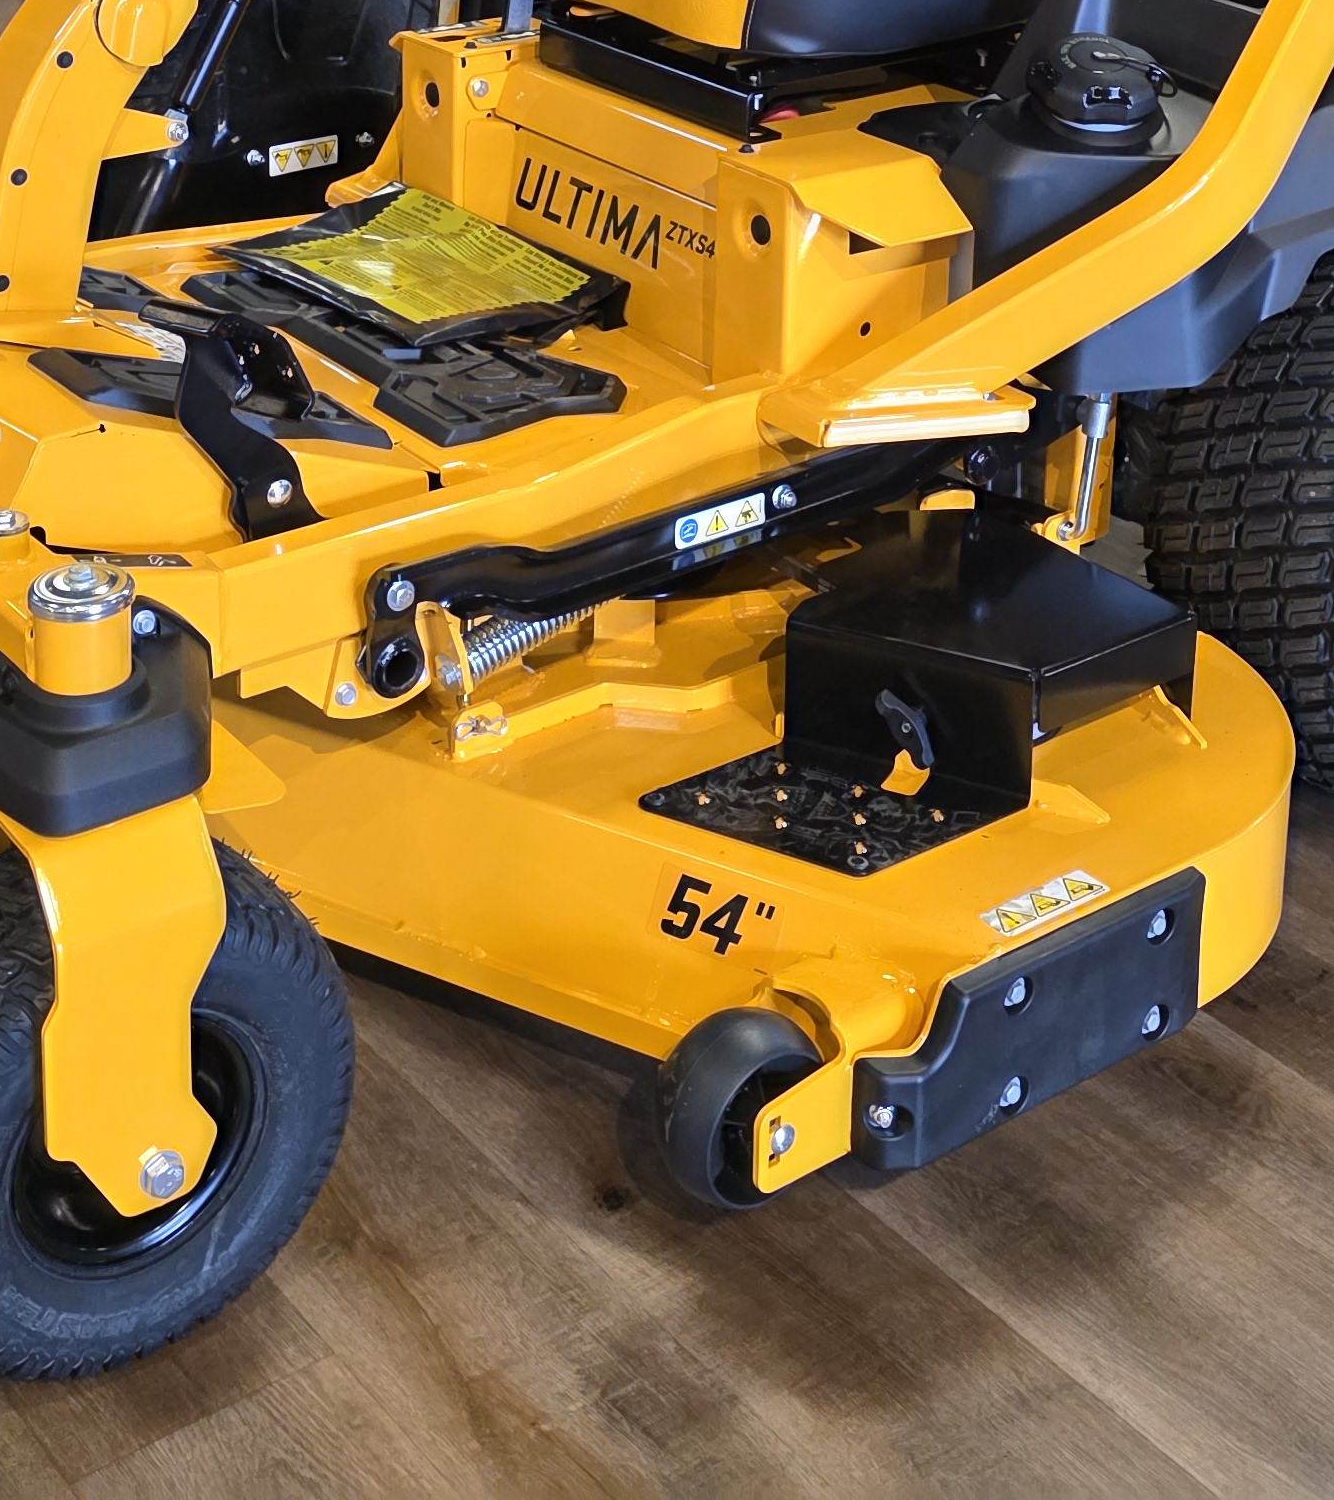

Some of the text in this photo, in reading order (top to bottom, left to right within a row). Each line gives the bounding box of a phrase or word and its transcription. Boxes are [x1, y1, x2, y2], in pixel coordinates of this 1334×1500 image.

[515, 156, 662, 270] ULTIMA
[665, 219, 716, 260] ZTXS4
[659, 873, 775, 957] 54"
